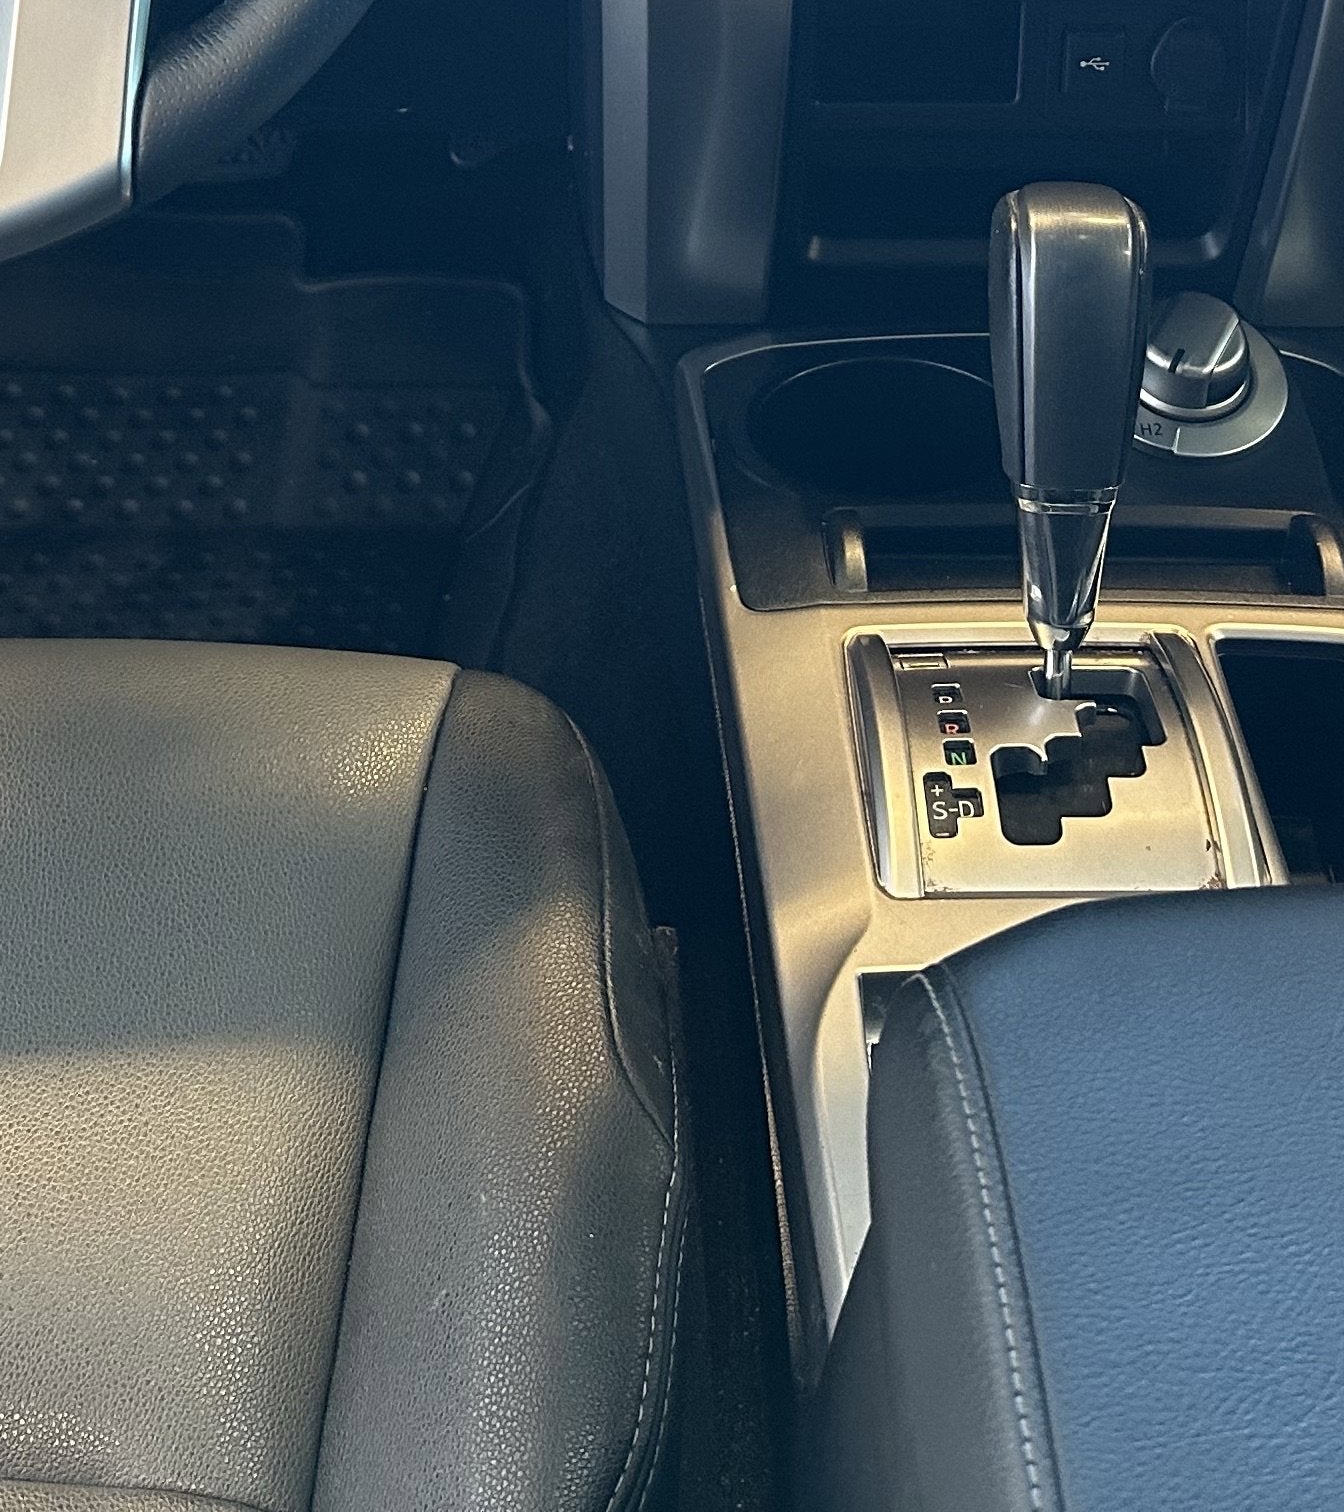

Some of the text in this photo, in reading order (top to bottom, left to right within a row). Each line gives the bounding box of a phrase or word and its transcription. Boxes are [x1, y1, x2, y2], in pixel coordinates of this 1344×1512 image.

[1140, 423, 1163, 437] H2
[944, 723, 960, 736] R
[950, 751, 967, 766] N
